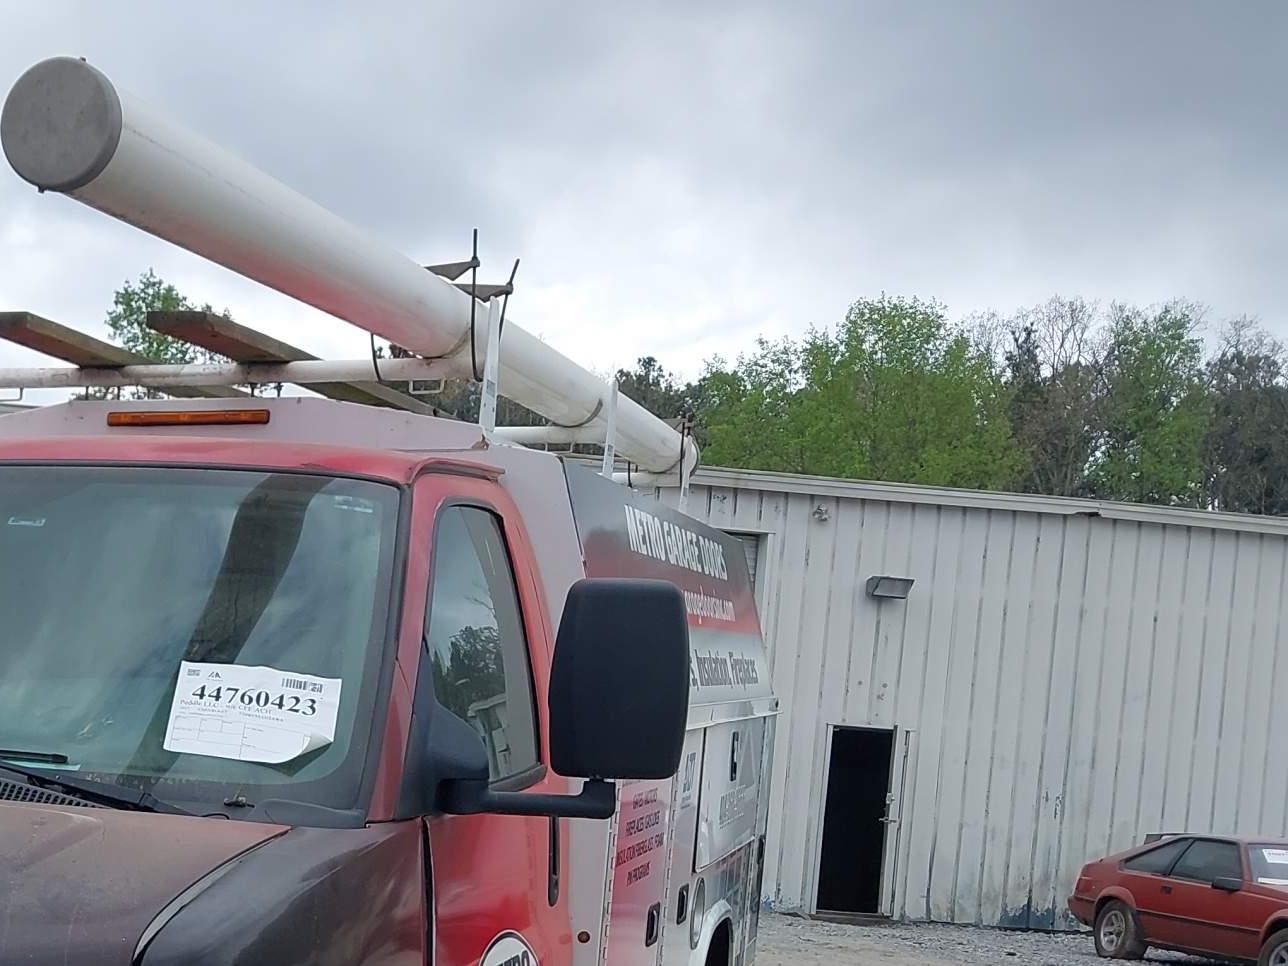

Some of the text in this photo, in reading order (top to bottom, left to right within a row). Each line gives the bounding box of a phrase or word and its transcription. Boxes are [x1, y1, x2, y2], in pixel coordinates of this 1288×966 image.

[624, 504, 728, 580] METRO GARAGE DOORS
[192, 684, 317, 716] 44760423
